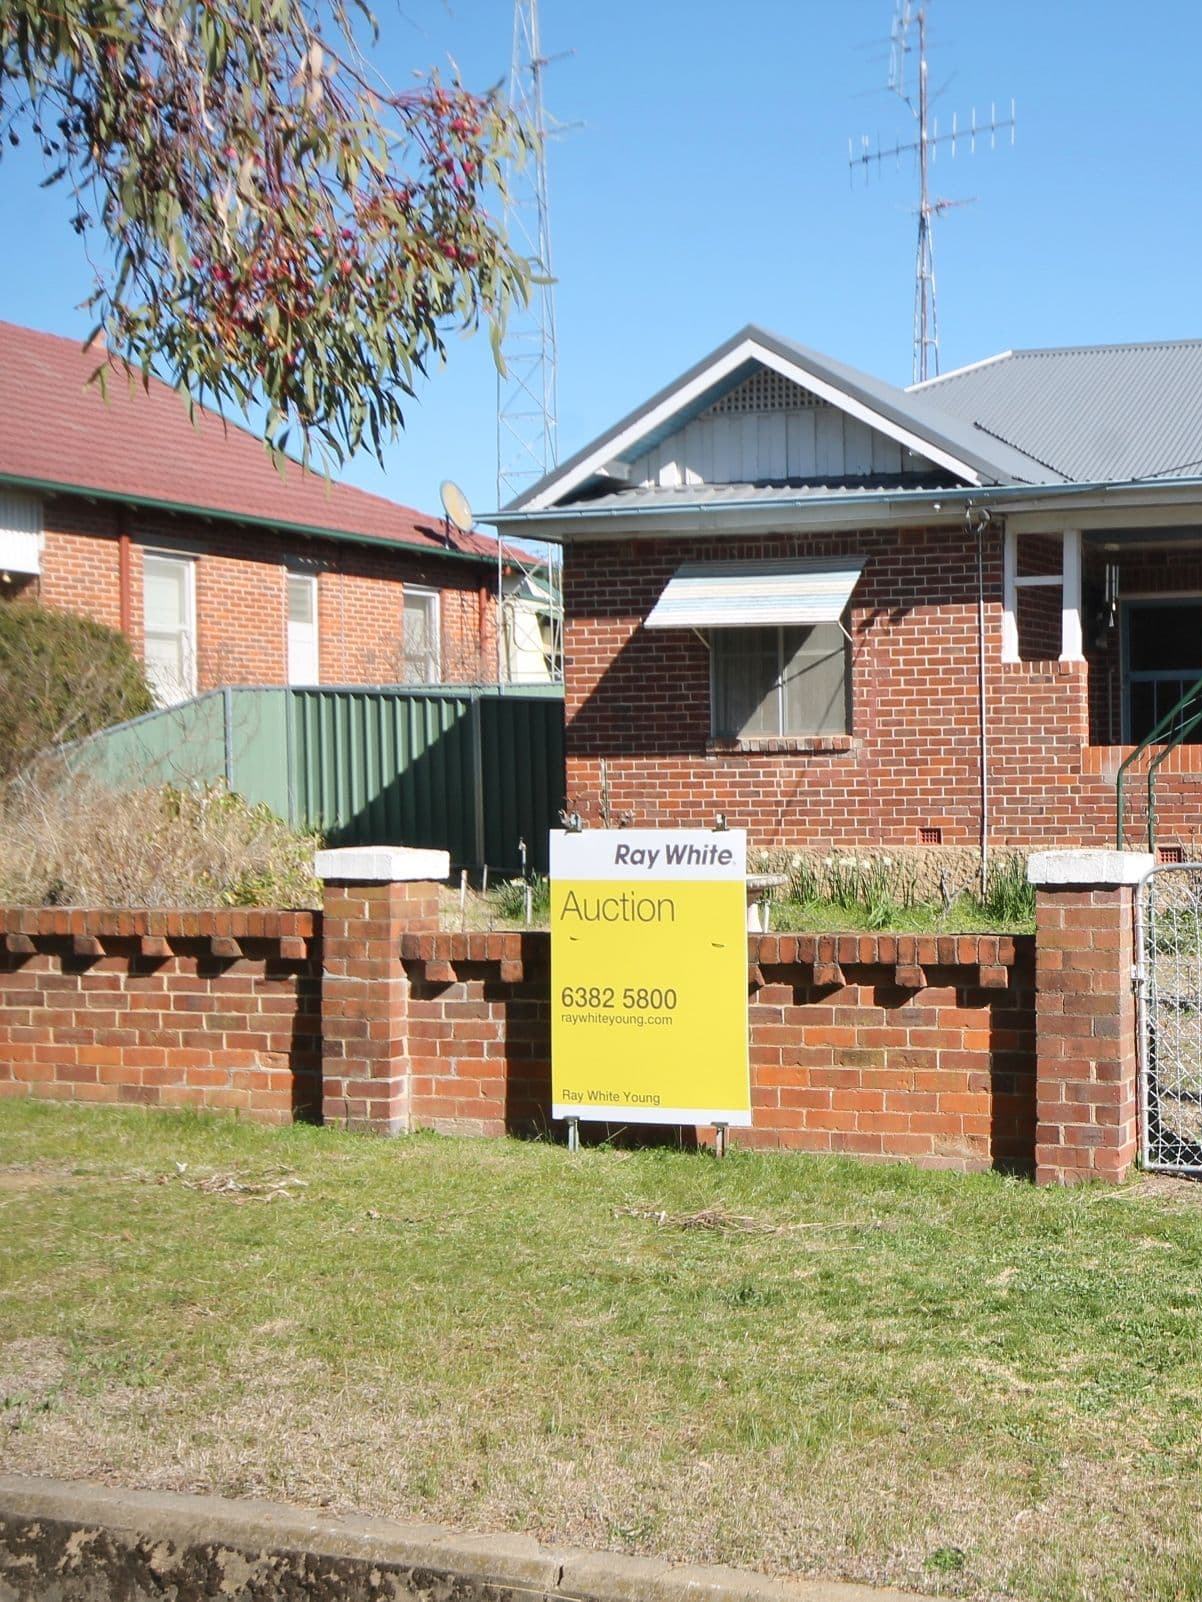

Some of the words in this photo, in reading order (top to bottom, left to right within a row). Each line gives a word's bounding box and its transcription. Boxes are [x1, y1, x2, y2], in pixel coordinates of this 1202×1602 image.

[614, 843, 661, 870] Ray
[665, 843, 733, 866] White
[560, 890, 676, 923] Auction
[561, 986, 615, 1009] 6382
[622, 988, 677, 1010] 5800
[561, 1012, 673, 1027] raywhiteyoung.com
[562, 1089, 584, 1103] Ray
[587, 1090, 620, 1102] White
[622, 1091, 661, 1106] Young
